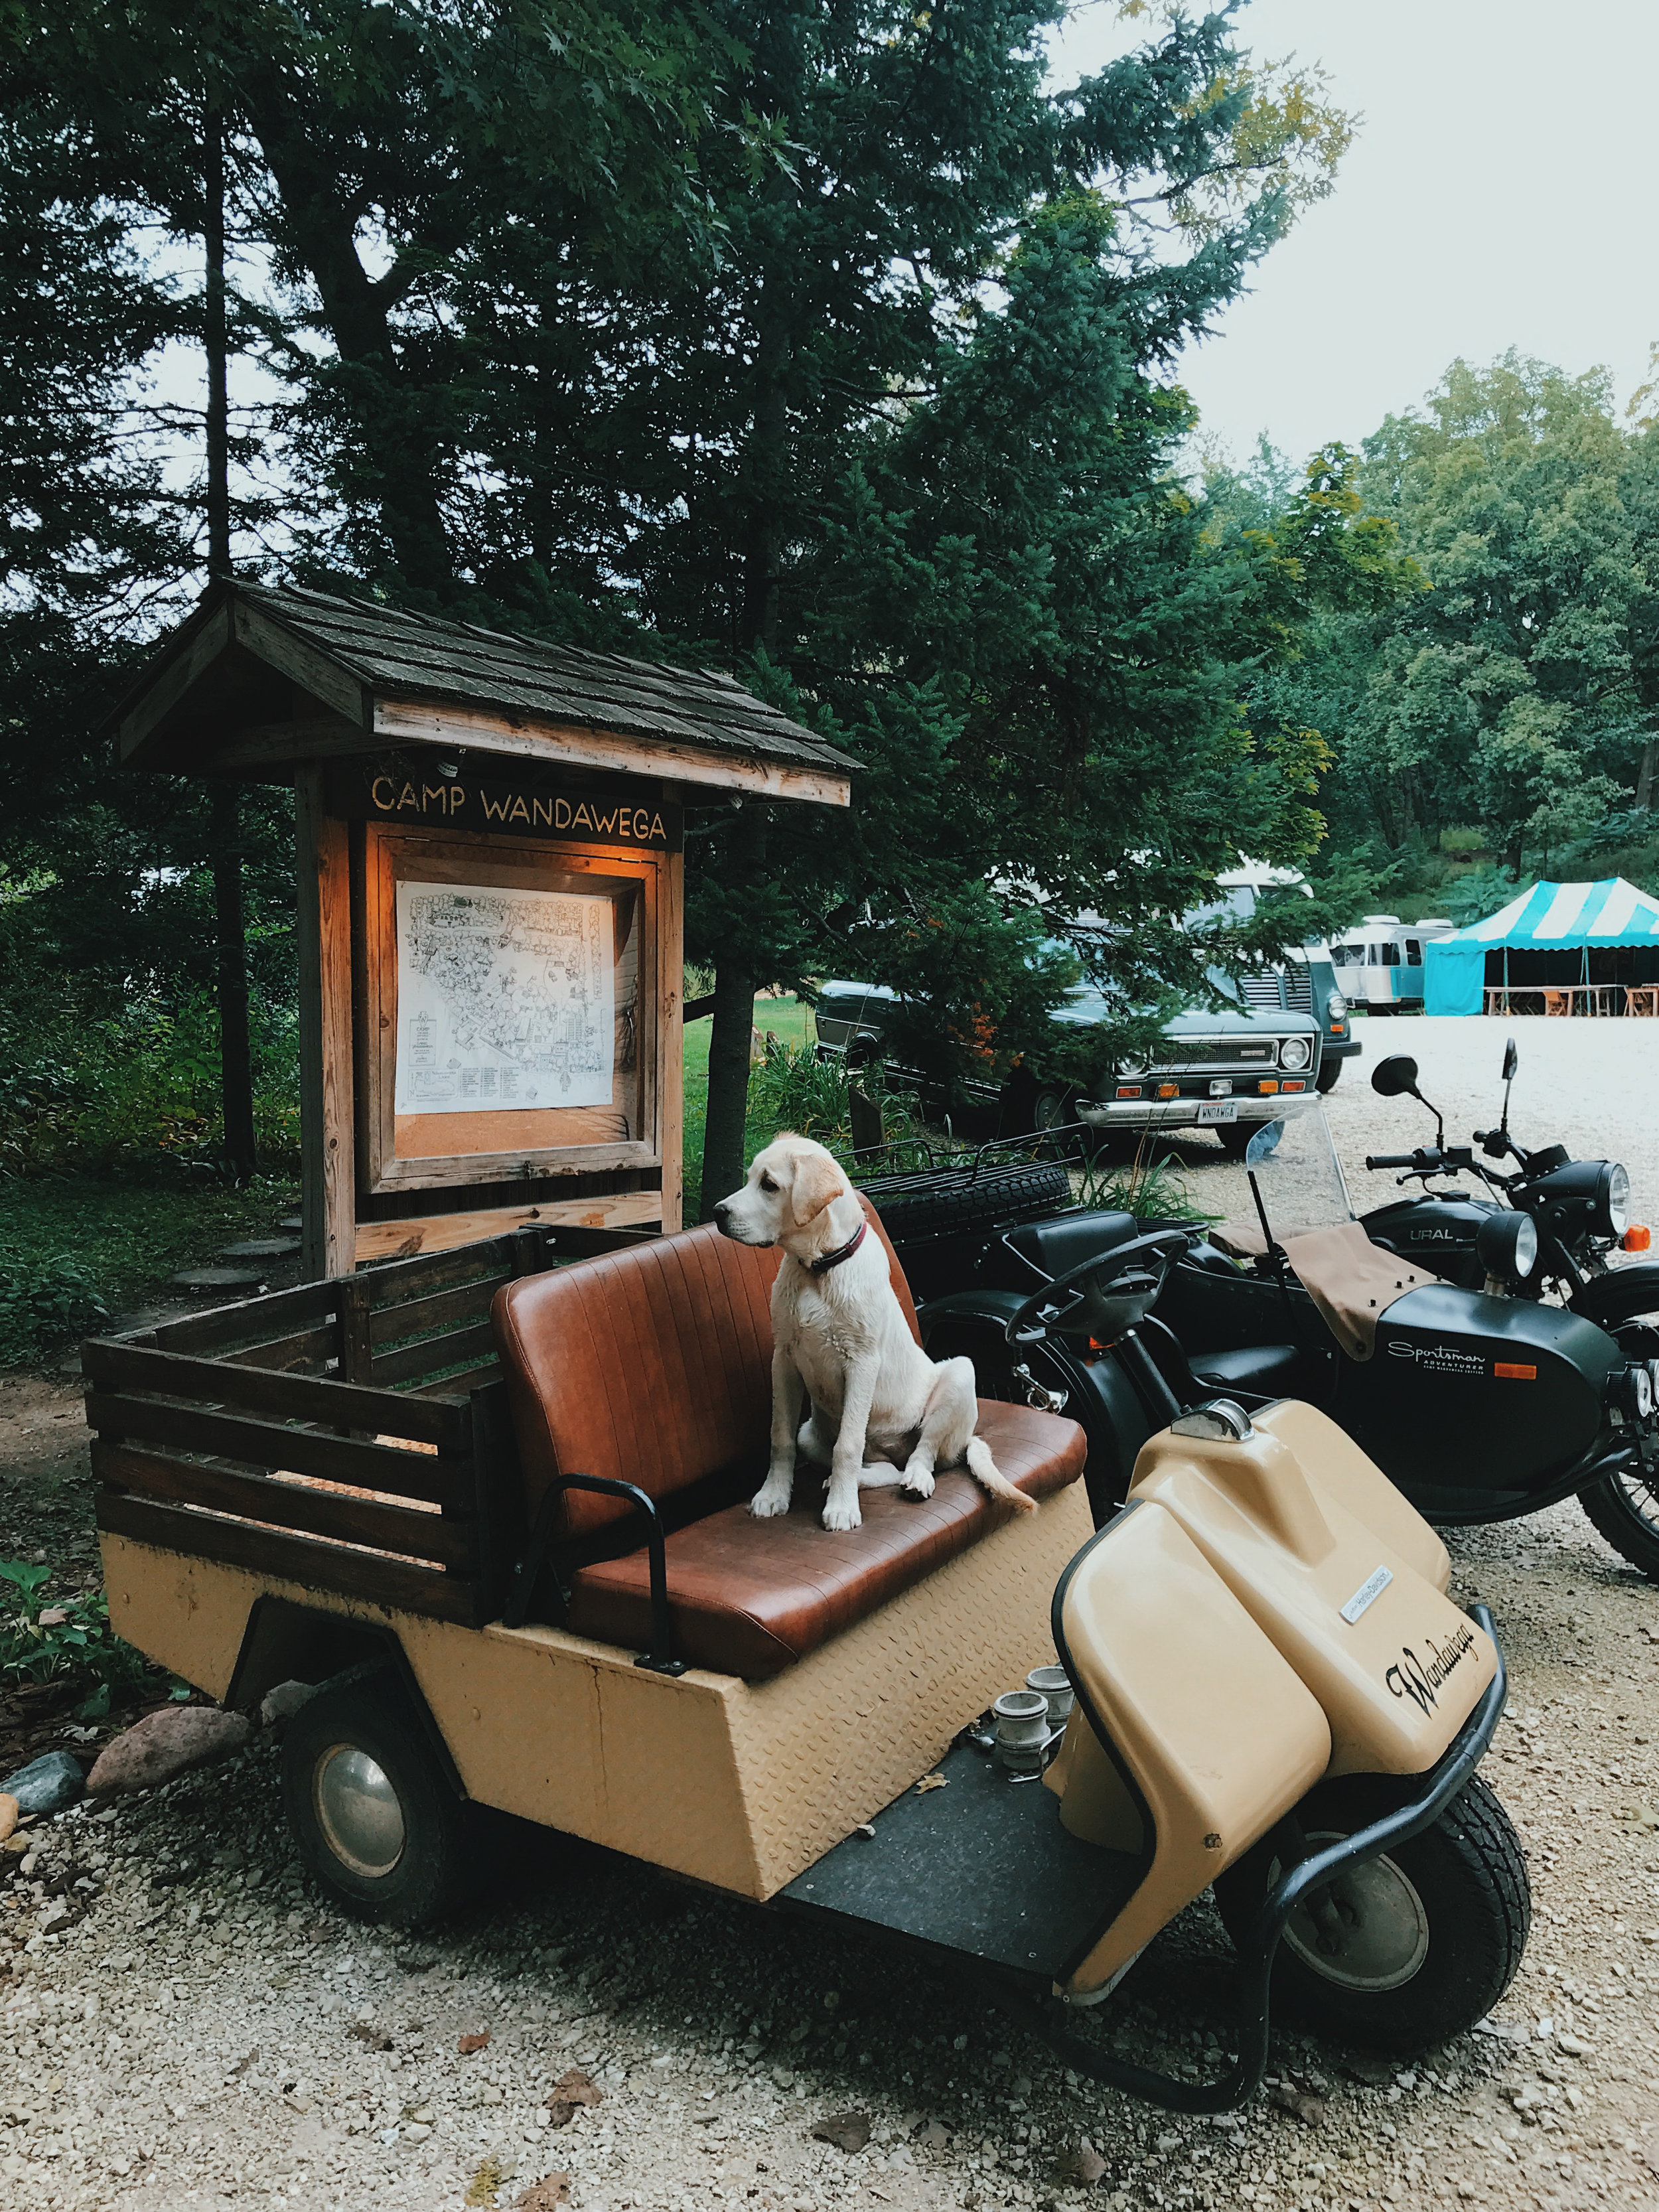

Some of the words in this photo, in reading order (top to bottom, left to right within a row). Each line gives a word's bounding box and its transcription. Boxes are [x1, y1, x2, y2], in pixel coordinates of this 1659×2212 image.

[372, 776, 465, 816] CAMP
[480, 789, 667, 841] WANDAWEGA
[1202, 1107, 1234, 1119] WNDAWGA
[1410, 1229, 1453, 1240] URAL
[1388, 1341, 1486, 1363] Sportsman
[1423, 1360, 1484, 1370] ADVENTURER
[1386, 1623, 1479, 1720] Wandawega
